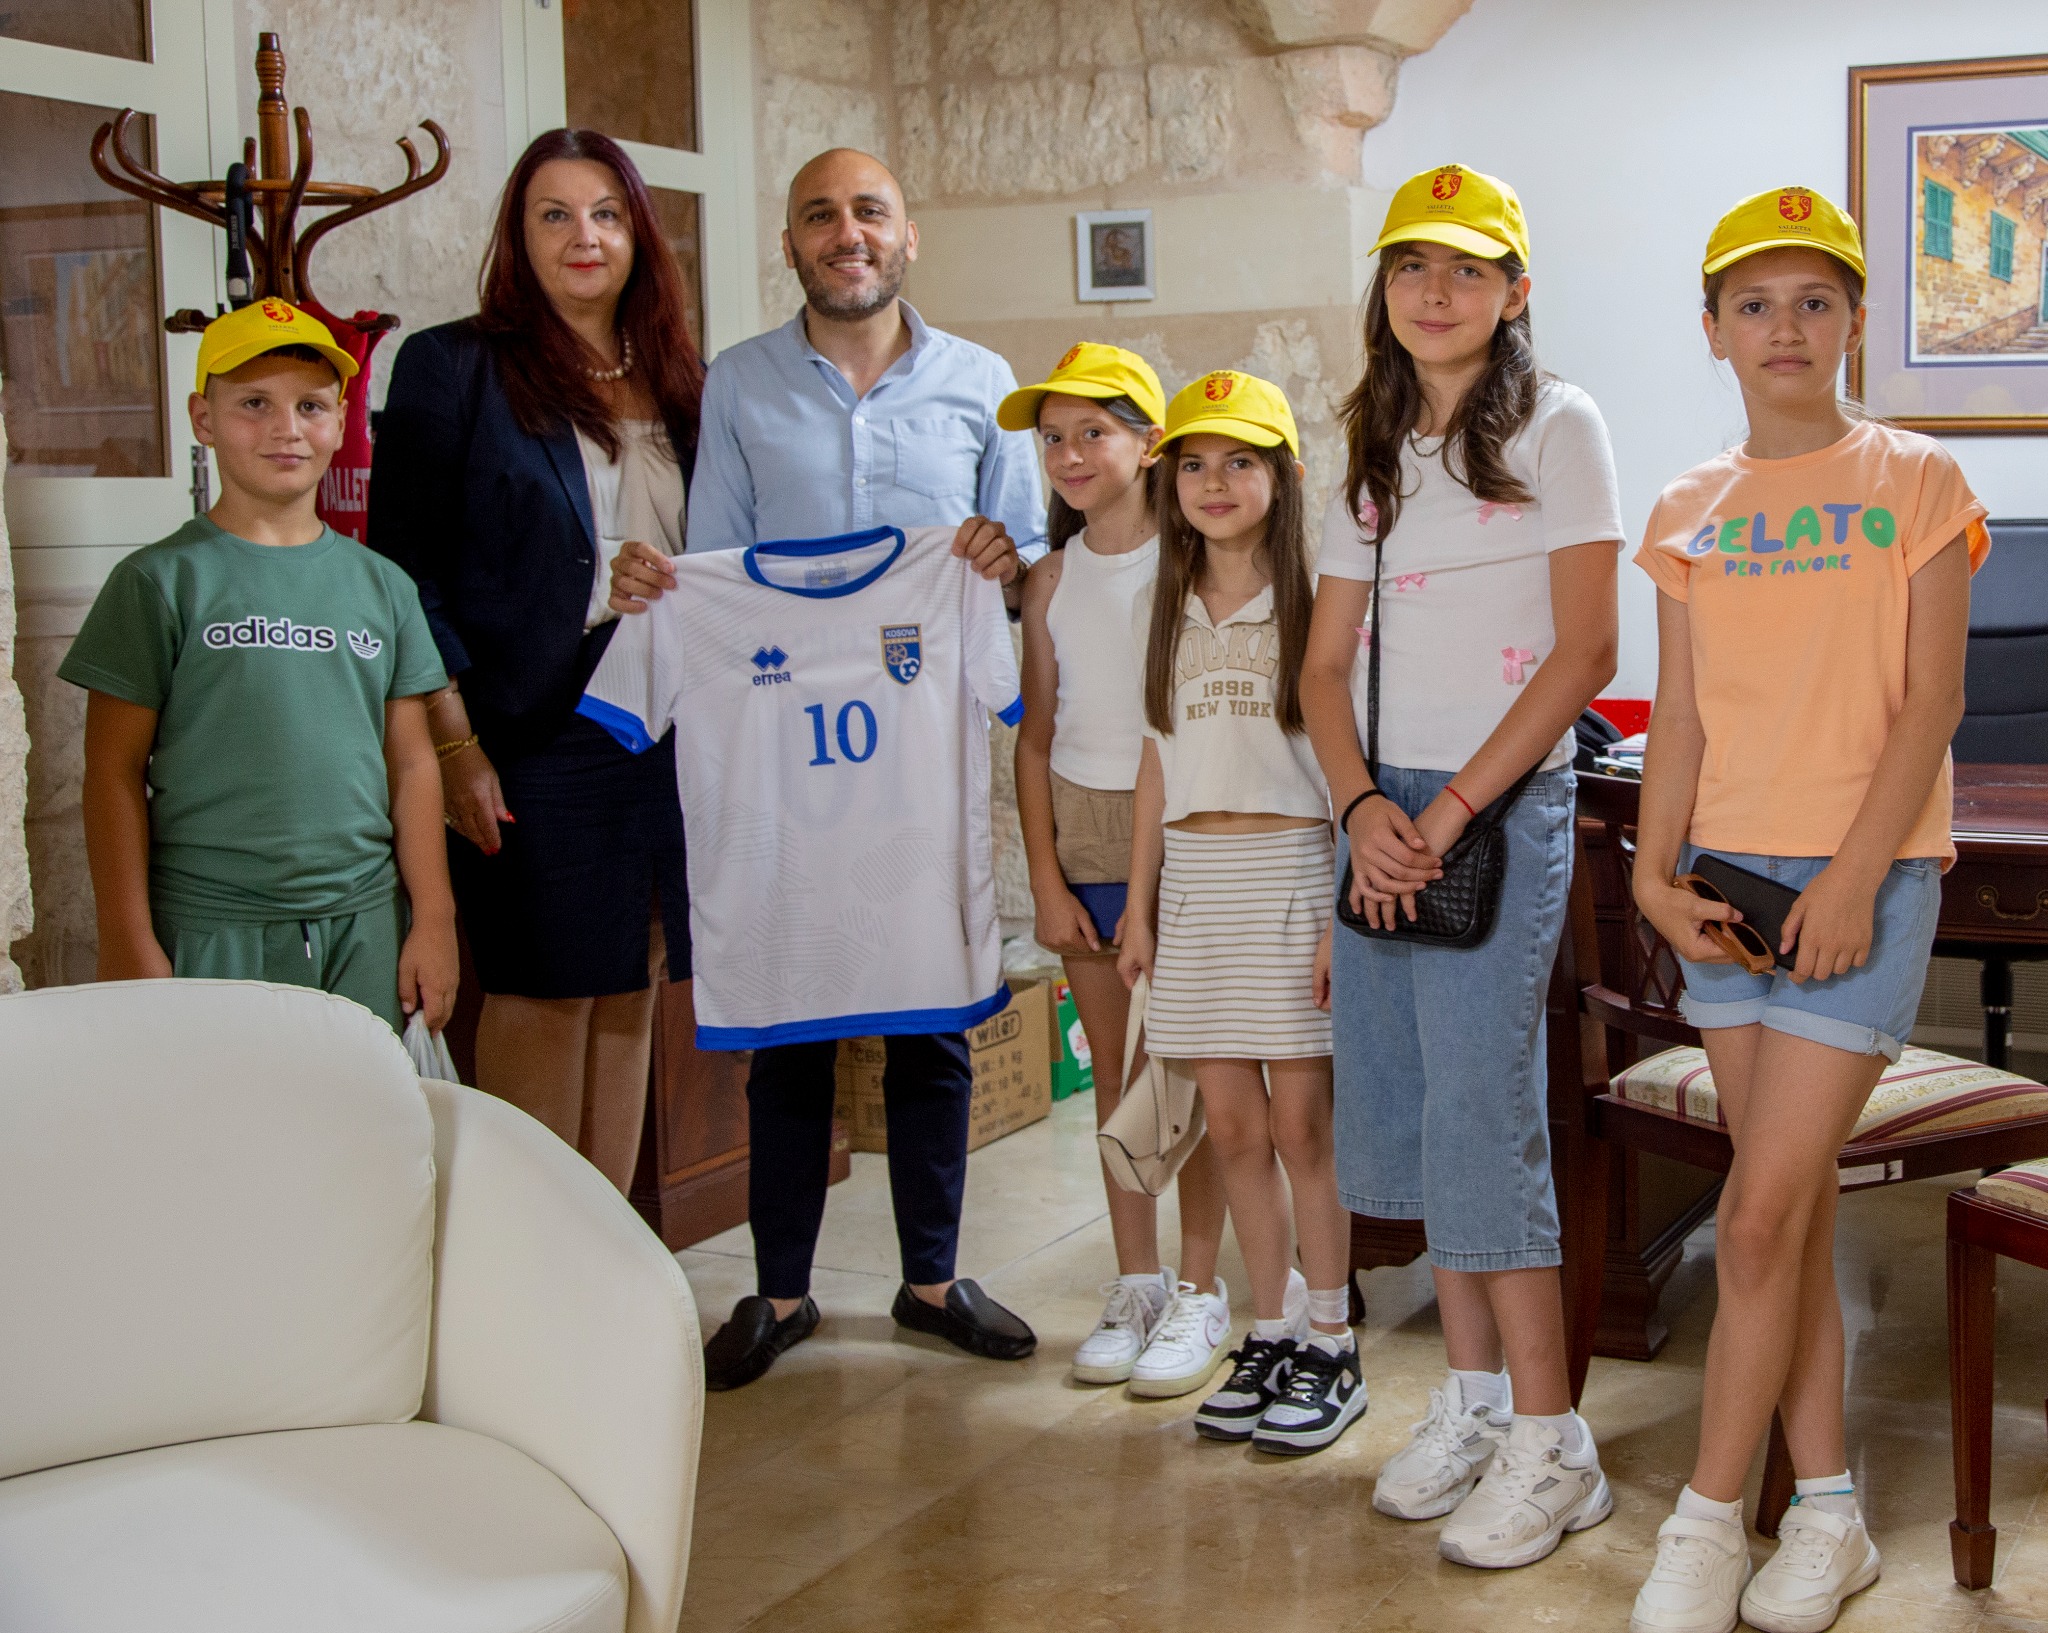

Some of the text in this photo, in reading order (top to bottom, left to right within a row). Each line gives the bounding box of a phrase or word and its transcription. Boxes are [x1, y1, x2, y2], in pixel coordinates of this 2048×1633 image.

[1686, 503, 1896, 556] GELATO
[1724, 553, 1852, 577] PER FAVORE
[203, 616, 337, 652] adidas
[885, 627, 918, 639] KOSOVA
[752, 670, 791, 686] errea
[1203, 680, 1254, 698] 1898
[1186, 699, 1271, 720] NEW YORK
[803, 699, 878, 767] 10
